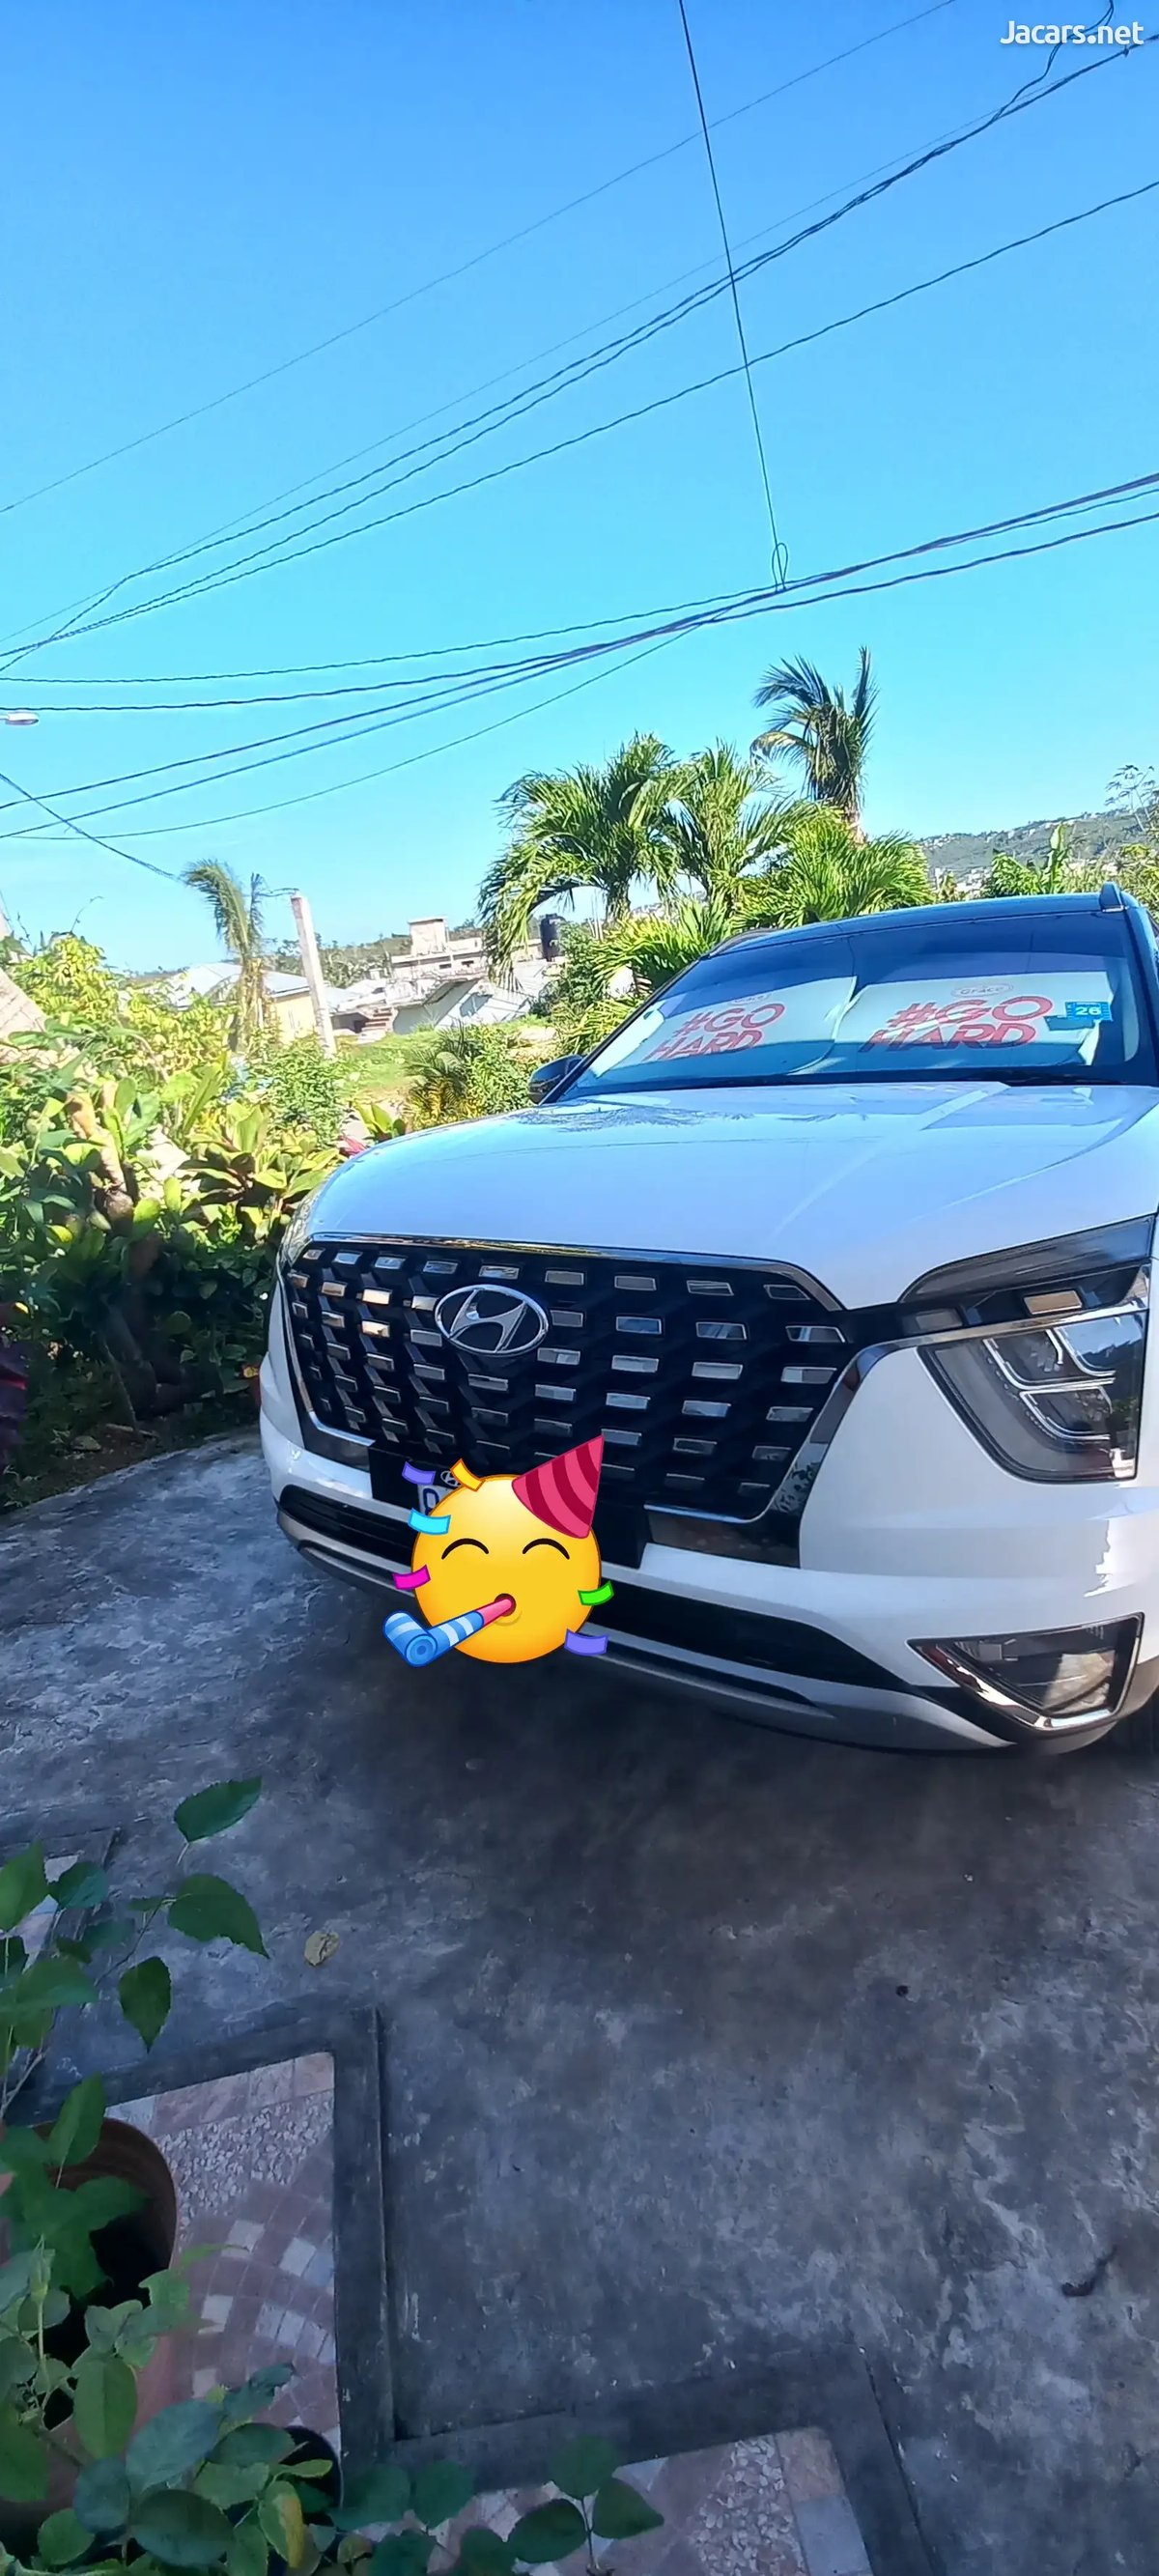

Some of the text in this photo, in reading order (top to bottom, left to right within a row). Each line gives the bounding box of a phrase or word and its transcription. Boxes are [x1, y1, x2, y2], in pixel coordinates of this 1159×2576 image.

[672, 1003, 785, 1037] #GO
[886, 995, 1054, 1028] #GO
[1075, 1005, 1102, 1016] 26
[641, 1030, 763, 1062] HARD
[858, 1023, 1036, 1053] HARD
